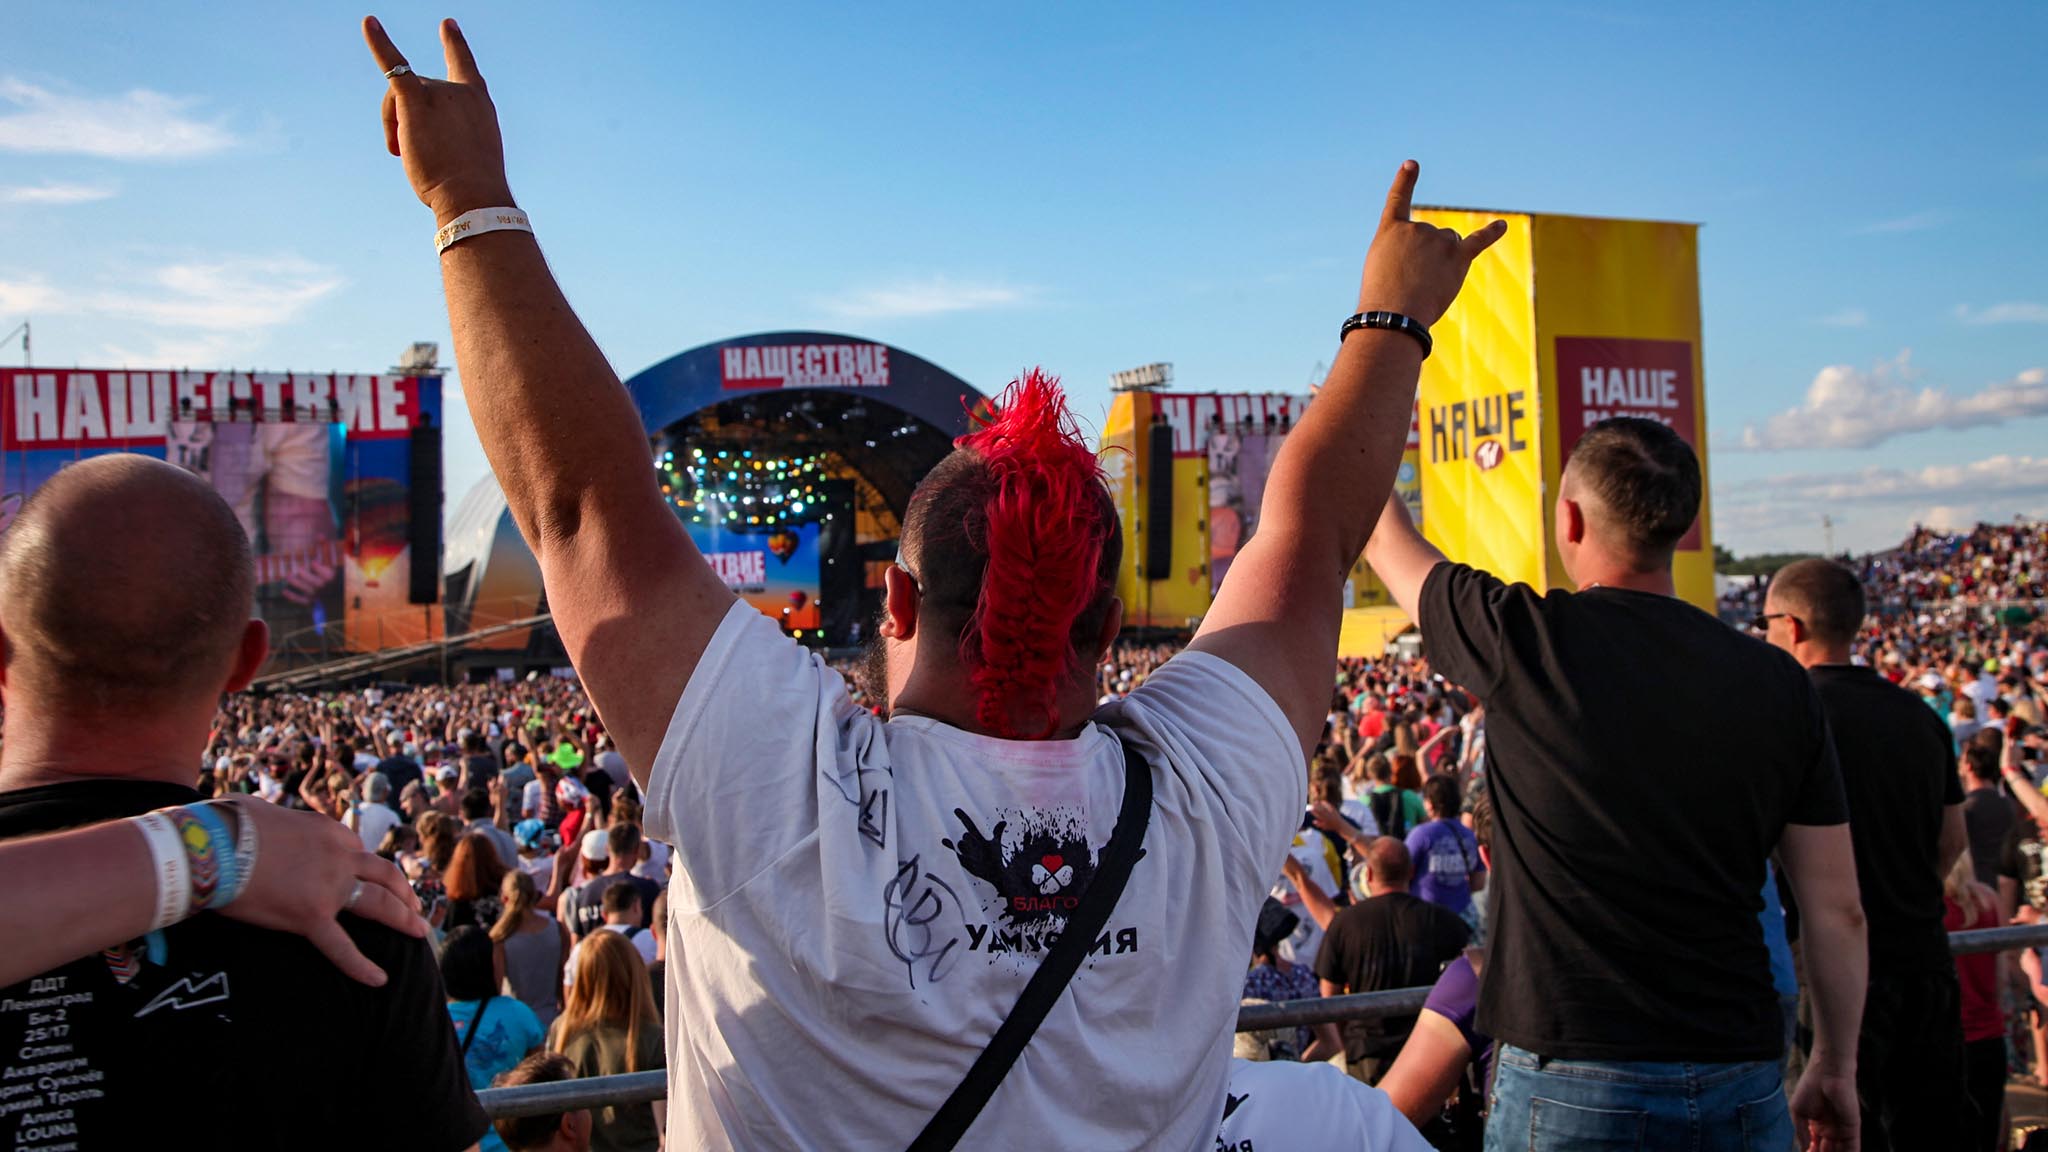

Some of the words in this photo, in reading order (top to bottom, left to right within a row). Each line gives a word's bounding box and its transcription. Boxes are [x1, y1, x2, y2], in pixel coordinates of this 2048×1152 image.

[725, 345, 888, 380] НАШЕСТВИЕ
[1580, 367, 1679, 408] НАШЕ
[1430, 391, 1526, 464] НАШЕ
[1013, 896, 1079, 911] БЛАГО
[965, 924, 1139, 956] УДМУРИЯ
[28, 976, 68, 994] ДДТ
[0, 991, 93, 1012] Ленинград
[28, 1009, 67, 1026] Би-2
[24, 1024, 70, 1042] 25/17
[2, 1057, 88, 1079] Аквариум
[0, 1095, 43, 1117] умий
[47, 1088, 104, 1106] Тролль
[20, 1108, 74, 1126] Алиса
[15, 1121, 78, 1144] LOUNA
